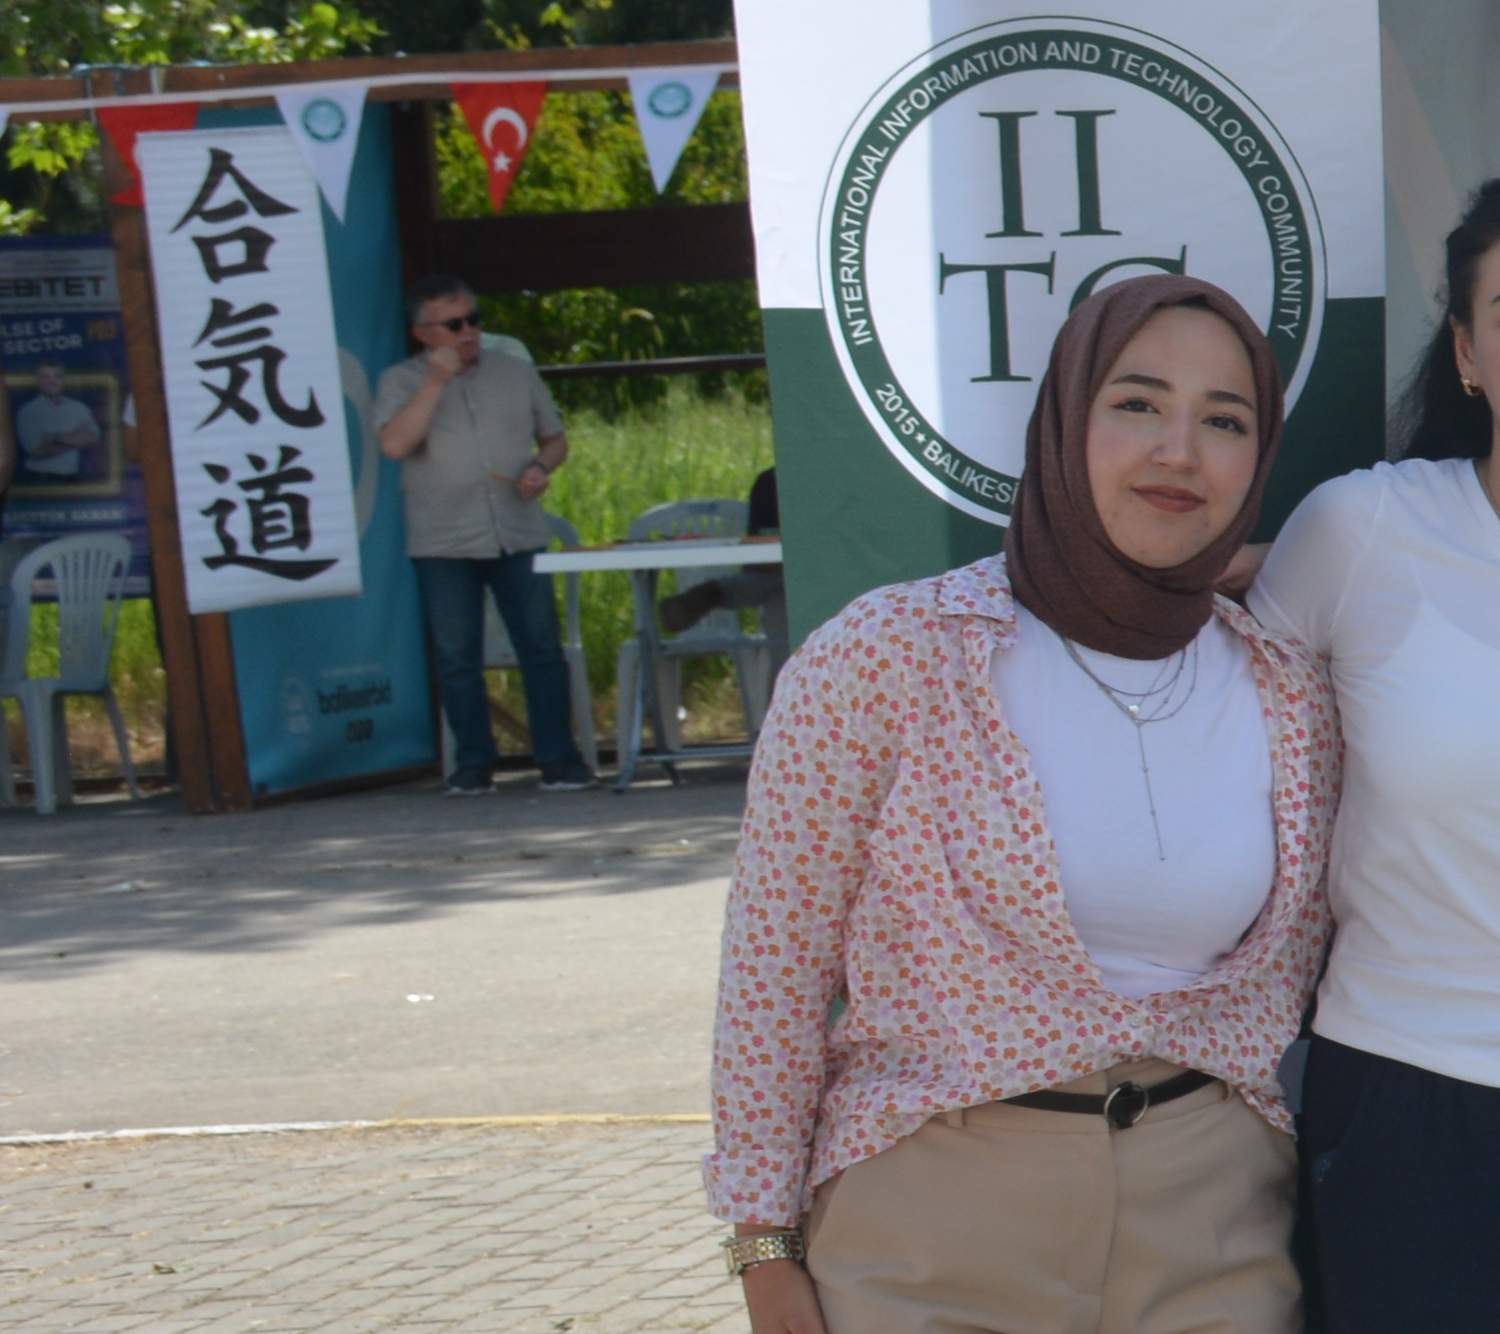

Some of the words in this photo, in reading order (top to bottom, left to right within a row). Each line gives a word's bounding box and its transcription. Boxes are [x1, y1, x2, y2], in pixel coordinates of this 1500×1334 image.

[838, 141, 890, 346] INTERNATIONAL
[879, 41, 1039, 141] INFORMATION
[1043, 41, 1101, 64] AND
[1108, 48, 1269, 170] TECHNOLOGY
[1257, 174, 1303, 340] COMMUNITY
[977, 108, 1122, 239] II
[169, 146, 340, 581] 合気道
[874, 383, 918, 437] 2015
